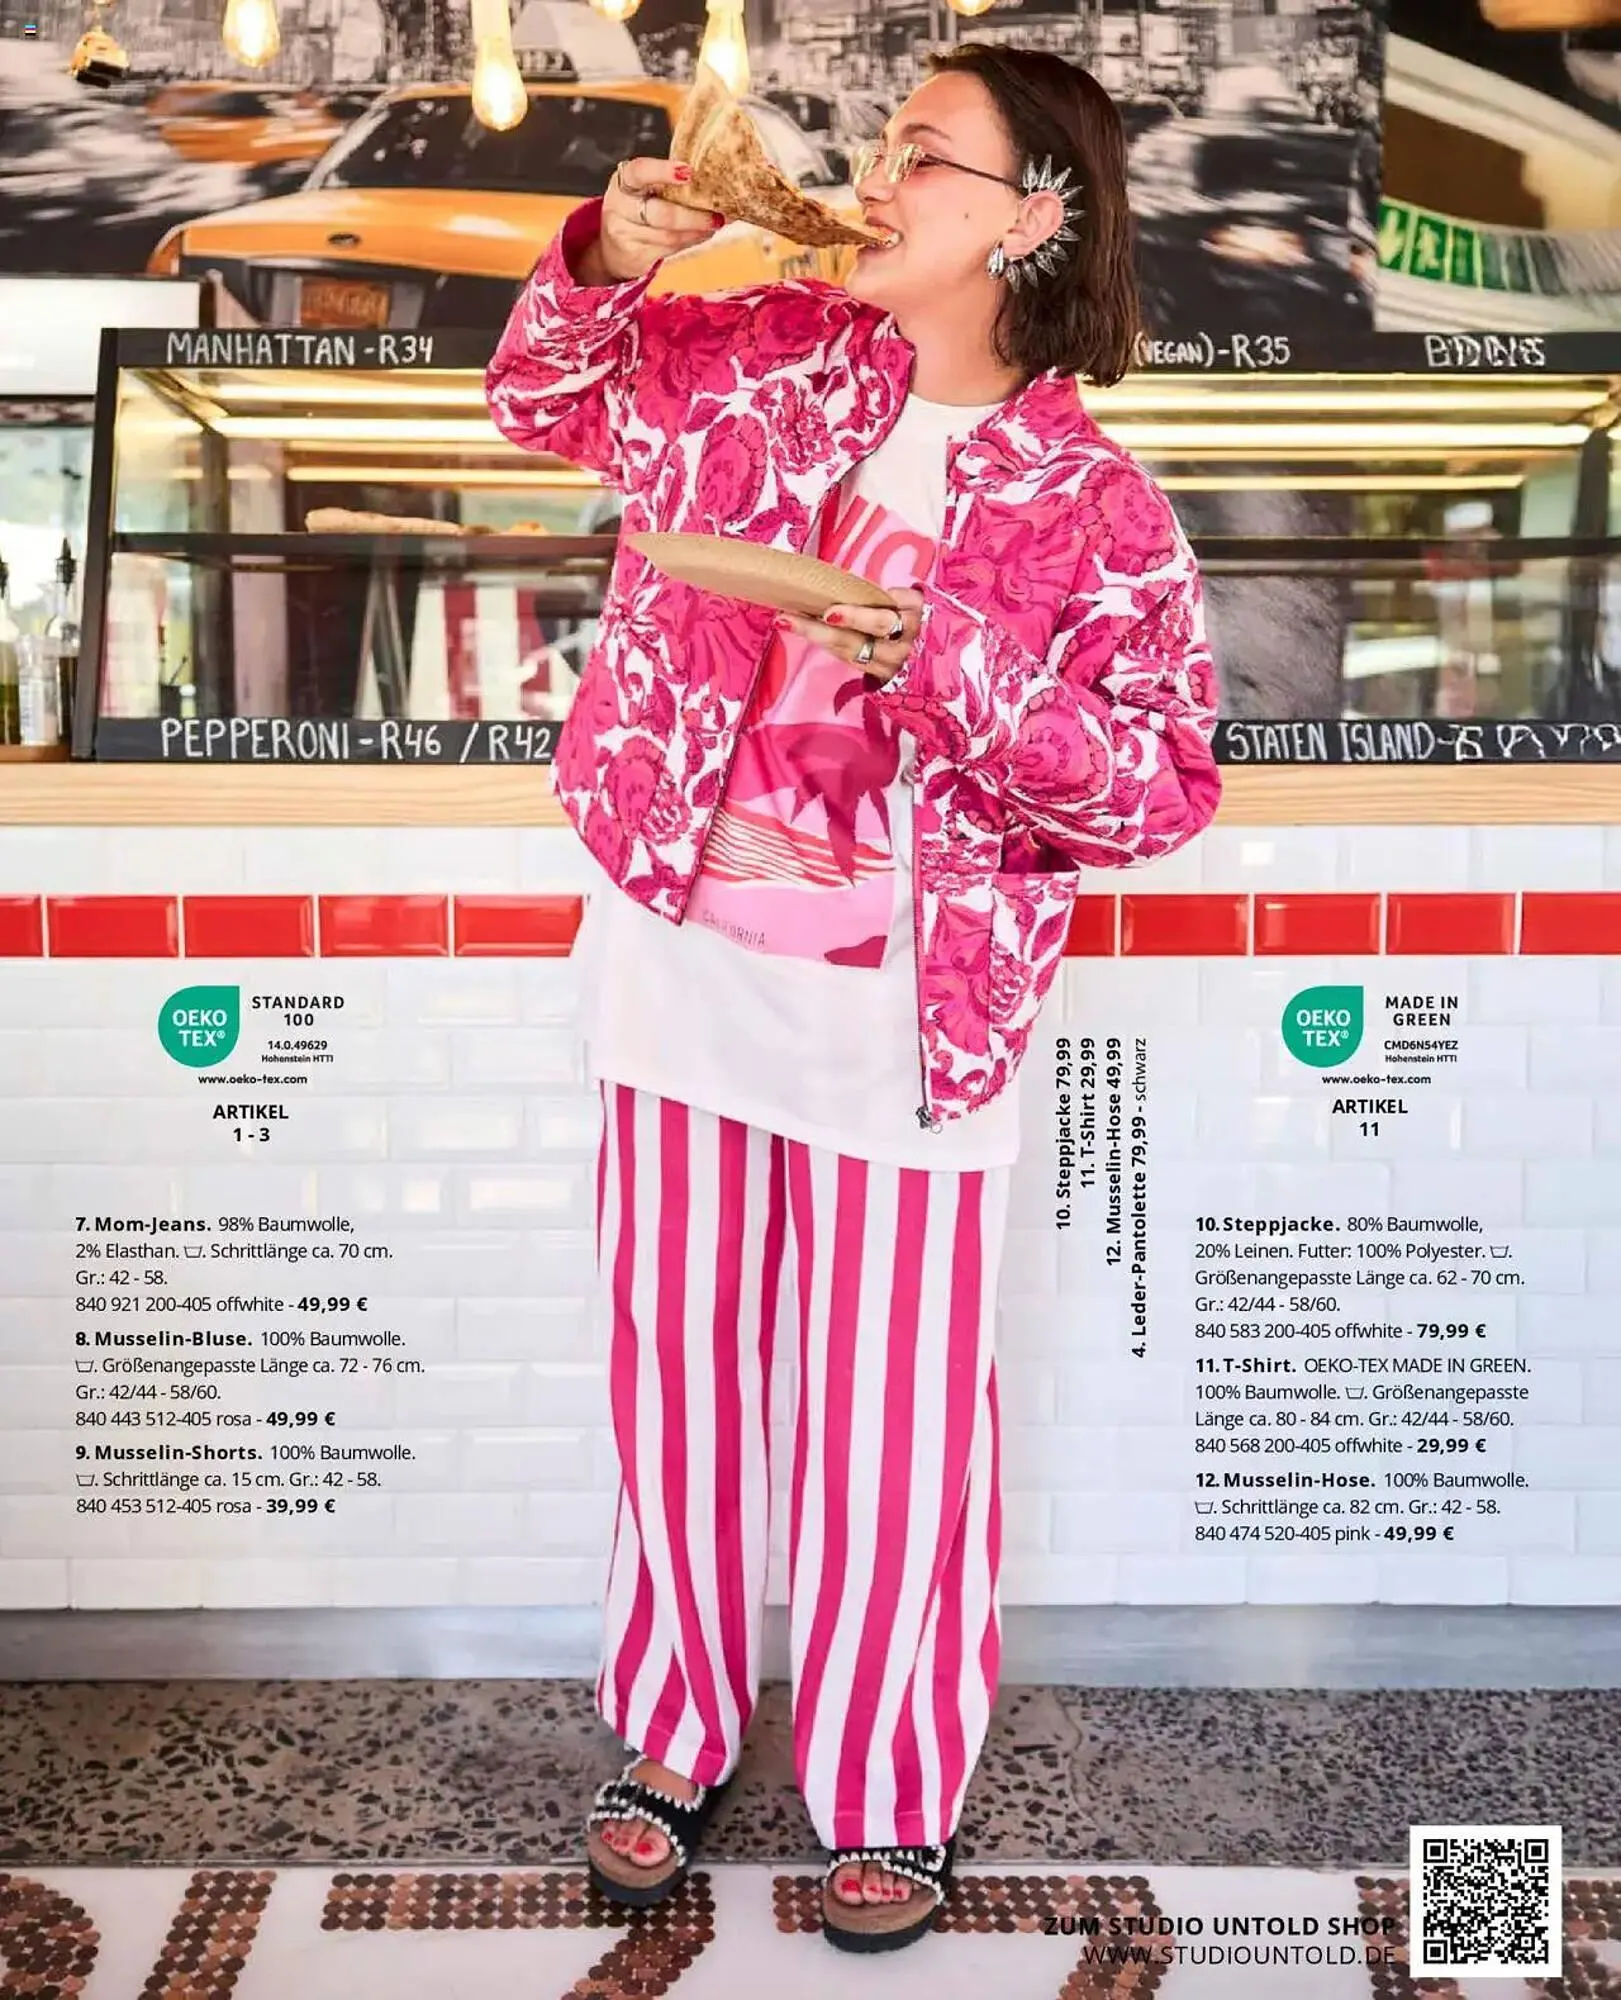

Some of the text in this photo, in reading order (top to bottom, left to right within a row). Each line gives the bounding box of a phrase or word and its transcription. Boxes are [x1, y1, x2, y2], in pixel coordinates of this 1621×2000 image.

[166, 331, 355, 366] MANHATTAN
[488, 723, 551, 761] R42
[1226, 722, 1328, 761] STATEN
